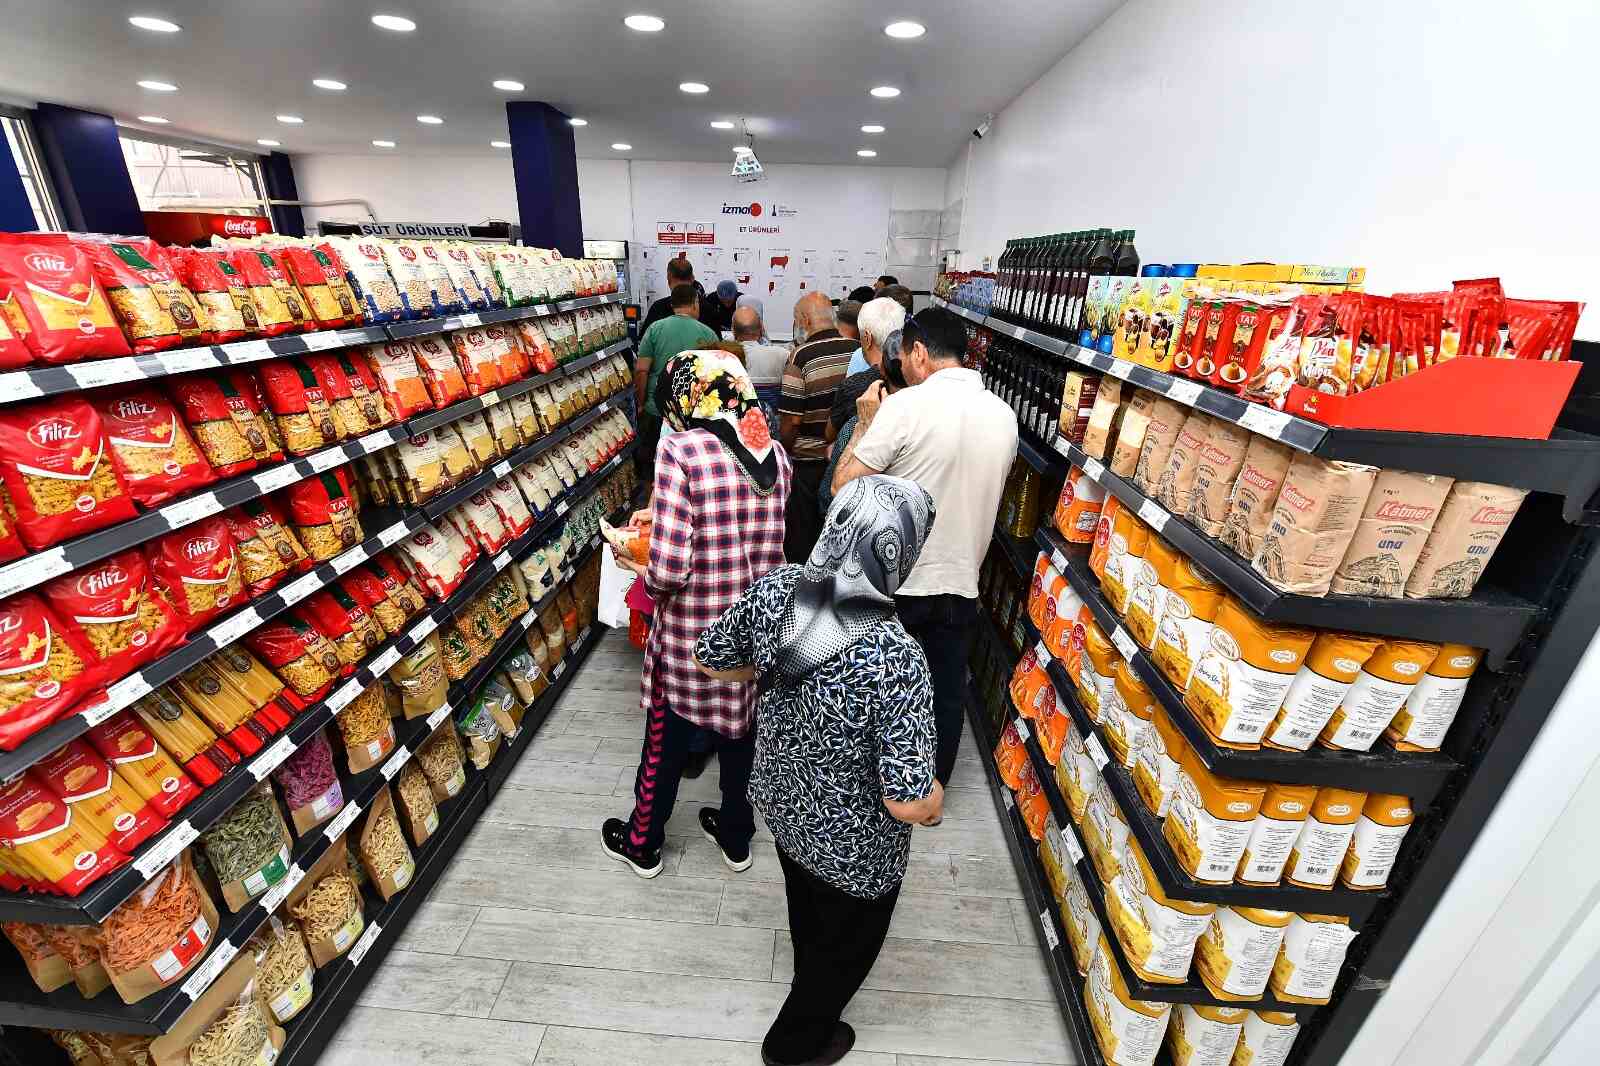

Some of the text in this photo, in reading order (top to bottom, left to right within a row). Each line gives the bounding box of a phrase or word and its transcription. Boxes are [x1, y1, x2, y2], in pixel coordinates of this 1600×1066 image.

[225, 219, 258, 235] Coca-Cola
[362, 223, 468, 238] SÜT ÜRÜNLERİ
[749, 224, 781, 234] ÜRÜNLERİ
[31, 256, 74, 272] filiz
[1239, 316, 1257, 325] TAT
[304, 391, 324, 400] TAT
[118, 400, 157, 418] filiz
[228, 399, 246, 409] TAT
[37, 422, 82, 444] filiz
[329, 499, 349, 511] TAT
[253, 513, 274, 527] TAT
[186, 540, 220, 560] filiz
[1377, 540, 1404, 550] una
[87, 569, 129, 594] filiz
[382, 576, 398, 589] TAT
[348, 606, 364, 621] TAT
[301, 629, 320, 644] TAT
